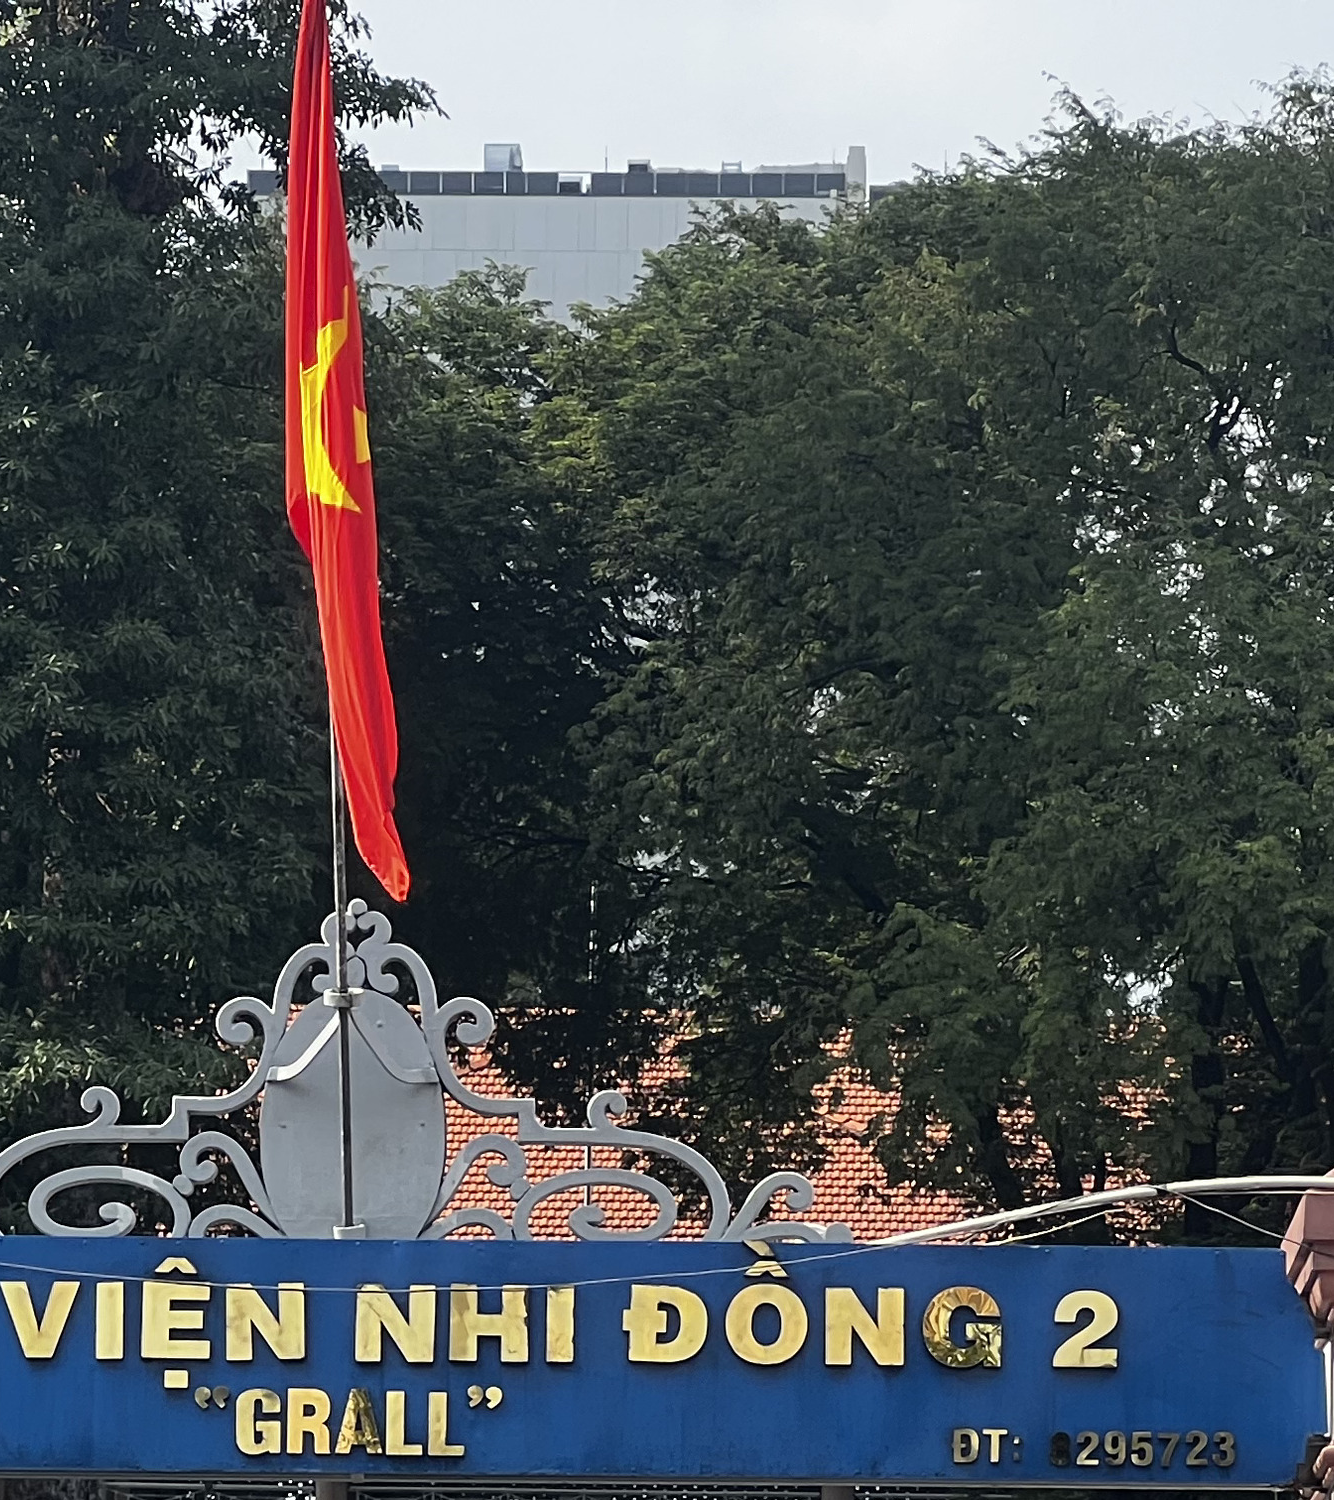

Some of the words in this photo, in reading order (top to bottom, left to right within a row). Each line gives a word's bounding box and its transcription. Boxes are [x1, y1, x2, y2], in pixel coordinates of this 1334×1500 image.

[1, 1256, 305, 1390] VIỆN
[354, 1282, 576, 1365] NHI
[623, 1239, 1004, 1369] ĐỒNG
[1051, 1289, 1119, 1368] 2
[952, 1427, 1021, 1463] ĐT:
